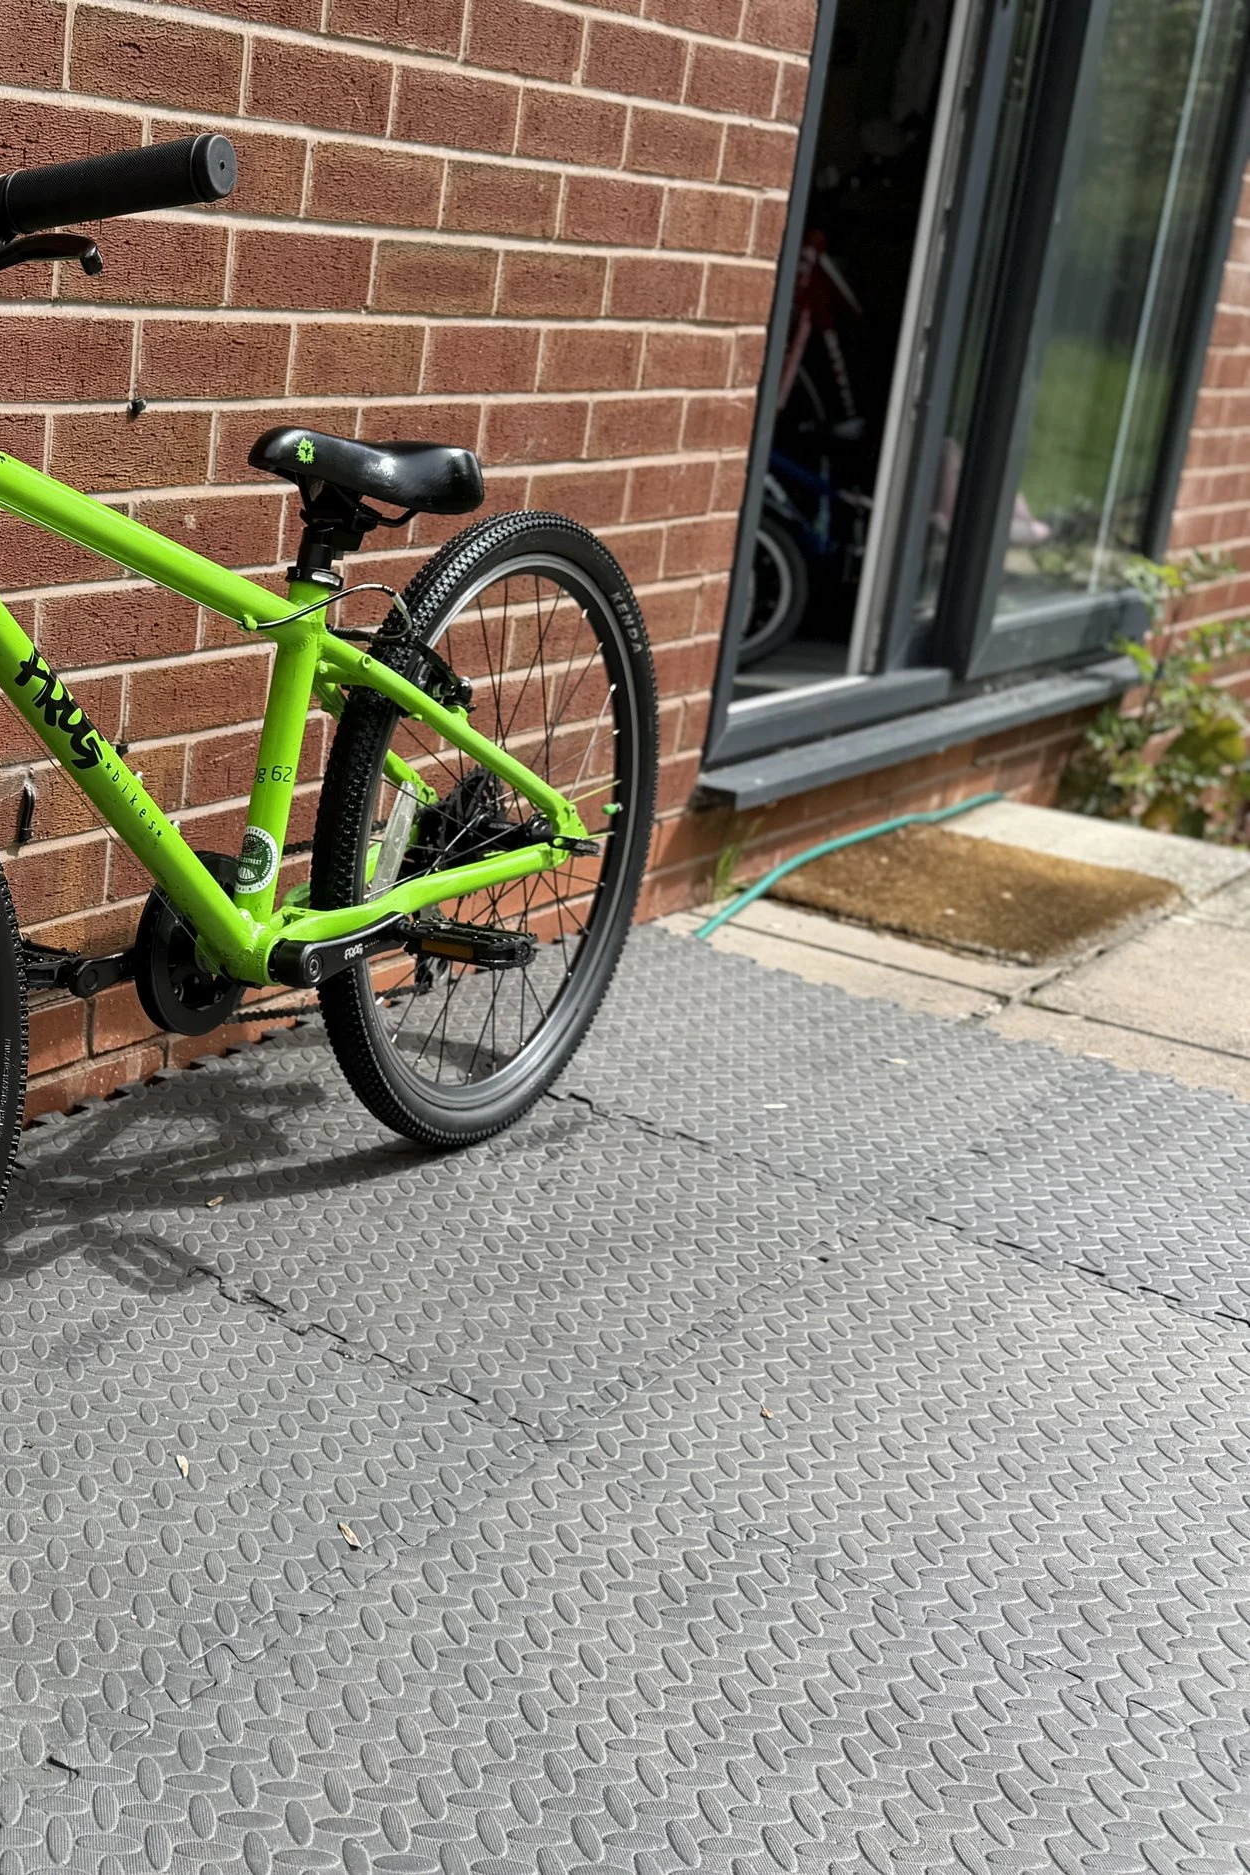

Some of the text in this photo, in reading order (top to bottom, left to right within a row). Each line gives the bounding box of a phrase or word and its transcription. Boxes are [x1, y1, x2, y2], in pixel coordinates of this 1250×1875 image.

[611, 591, 643, 654] KENDA
[15, 646, 158, 831] FROG bikes
[271, 765, 293, 782] 62
